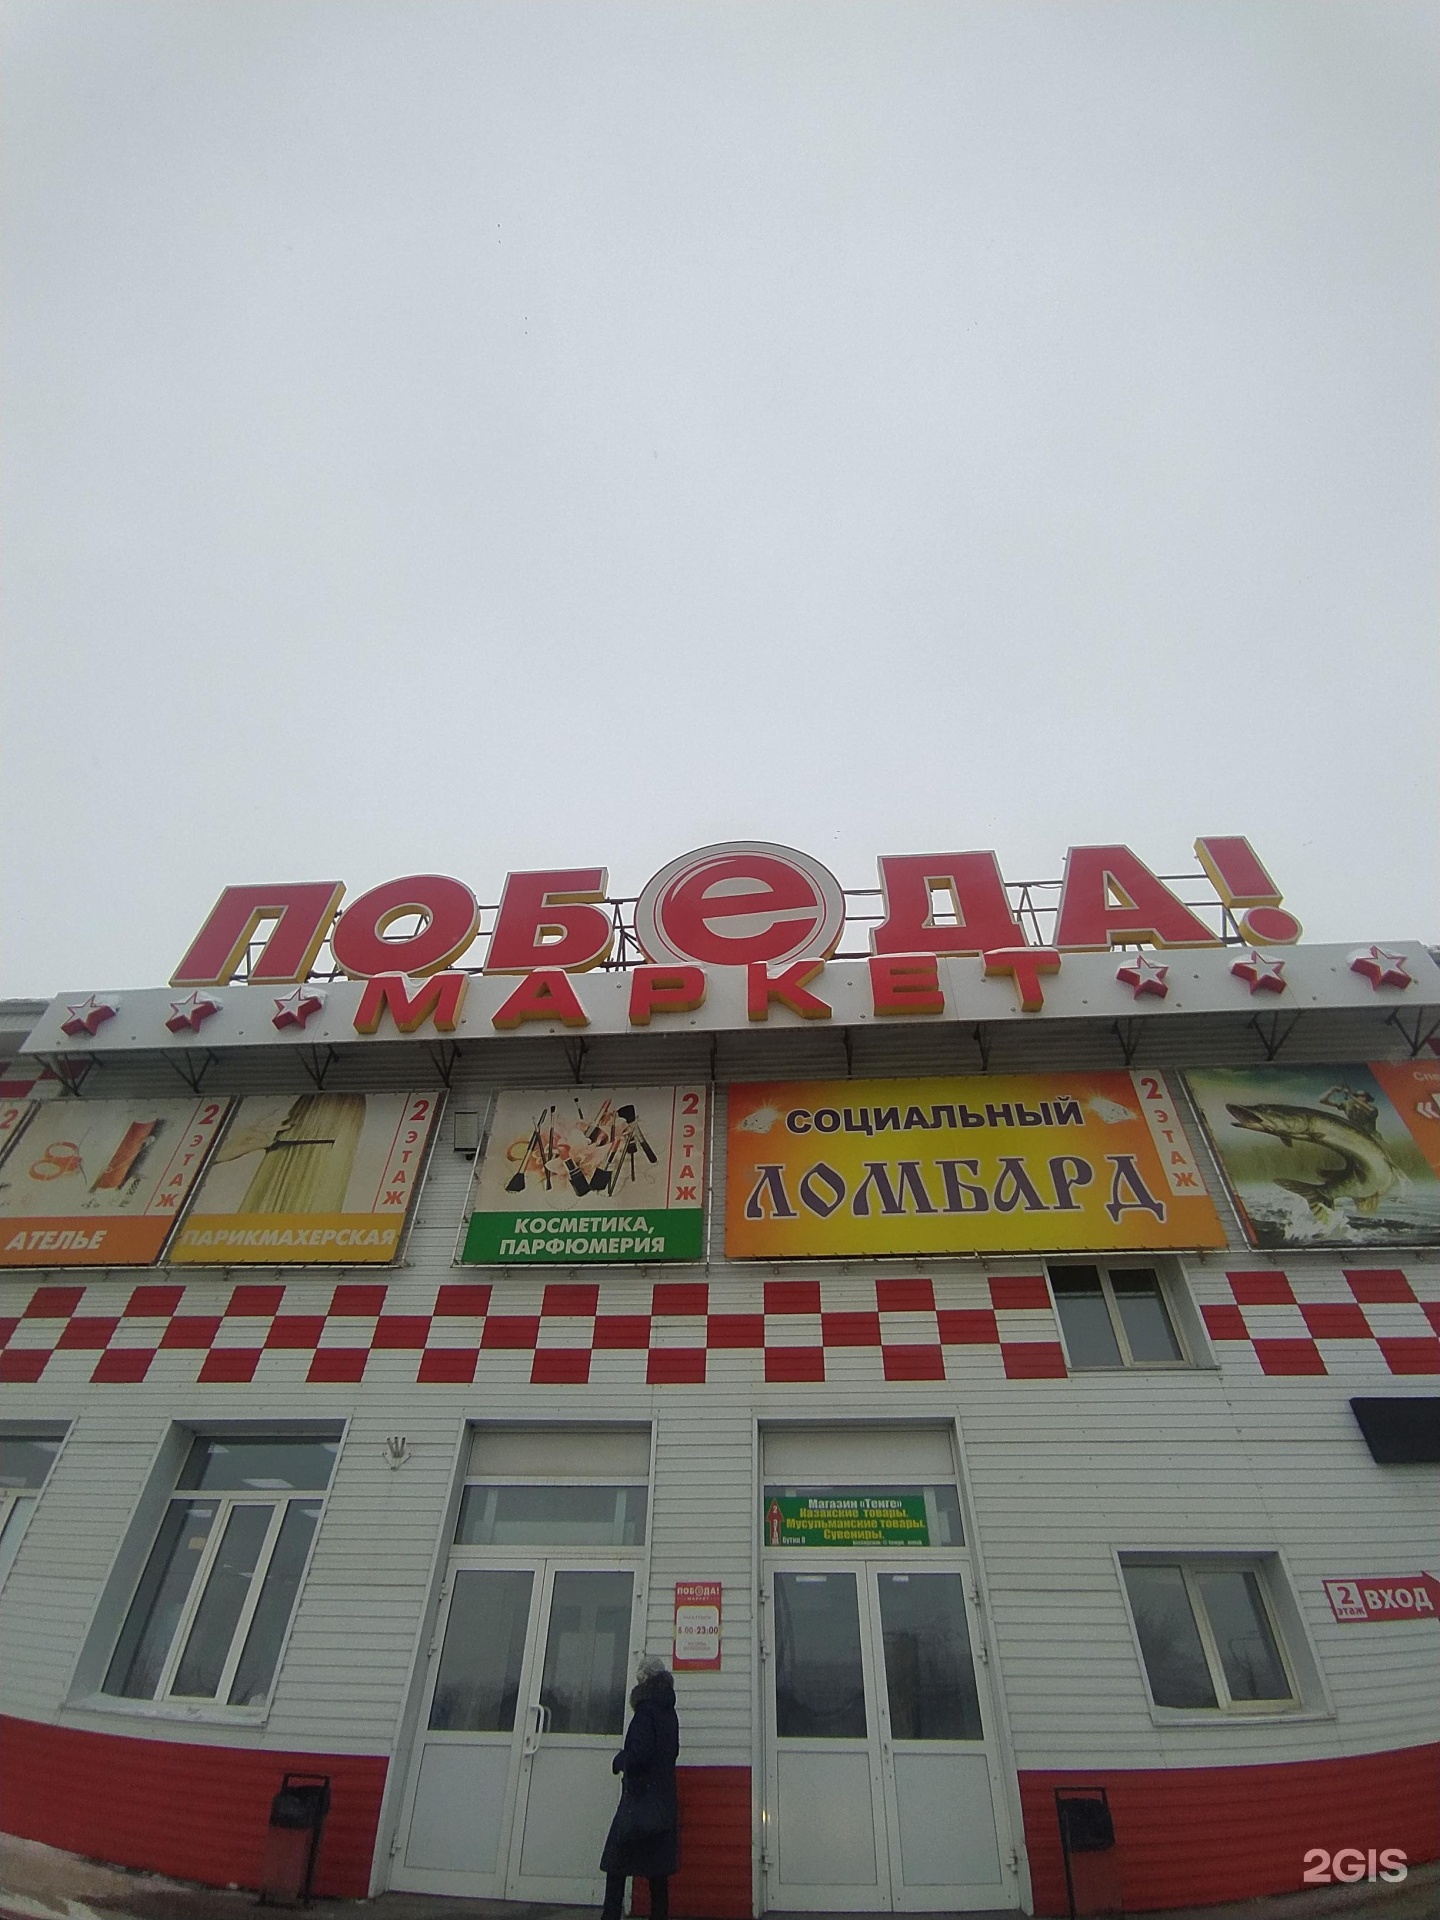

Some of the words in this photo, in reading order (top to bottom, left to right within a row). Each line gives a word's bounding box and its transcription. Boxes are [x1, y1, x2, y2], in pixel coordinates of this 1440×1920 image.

[352, 947, 1062, 1035] МАРКЕТ
[409, 1100, 430, 1121] 2
[682, 1093, 700, 1114] 2
[198, 1104, 220, 1125] 2
[786, 1096, 1085, 1136] СОЦИАЛЬНЫЙ
[1141, 1077, 1163, 1100] 2
[1154, 1109, 1197, 1188] ЭТАЖ
[155, 1135, 203, 1207] ЭТАЖ
[382, 1131, 418, 1205] ЭТАЖ
[675, 1125, 697, 1200] ЭТАЖ
[745, 1153, 1167, 1223] ЛОМБАРД
[514, 1217, 655, 1235] КОСМЕТИКА,
[4, 1230, 107, 1250] АТЕЛЬЕ
[180, 1229, 397, 1247] ПАРИКМАХЕРСКАЯ
[499, 1237, 665, 1255] ПАРФЮМЕРИЯ
[808, 1499, 858, 1508] Магазин
[786, 1519, 877, 1530] Мусульманские
[1336, 1586, 1354, 1605] 2
[1364, 1587, 1434, 1611] ВХОД
